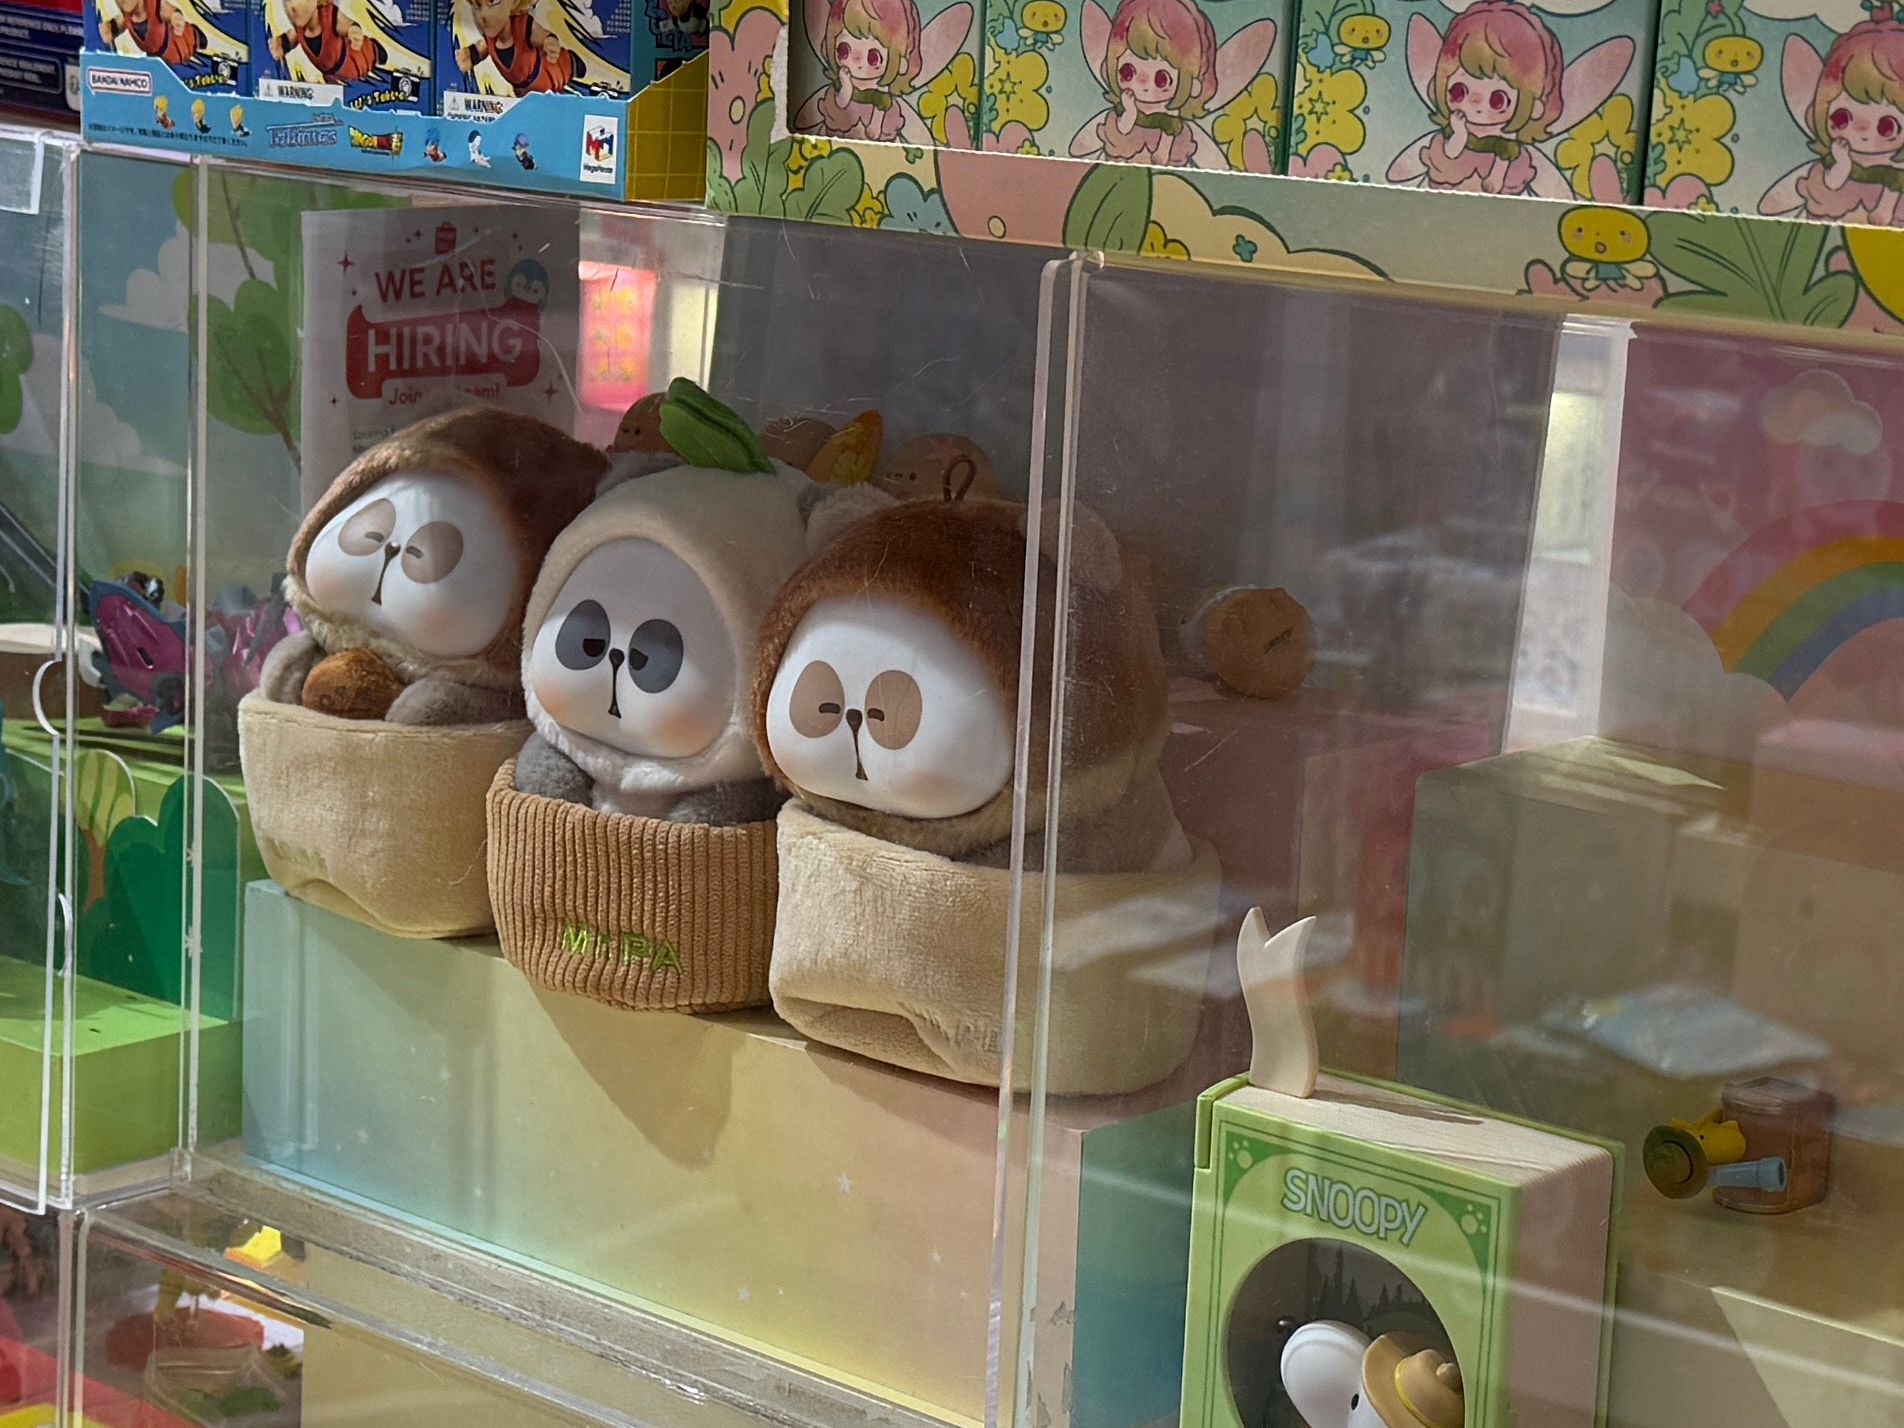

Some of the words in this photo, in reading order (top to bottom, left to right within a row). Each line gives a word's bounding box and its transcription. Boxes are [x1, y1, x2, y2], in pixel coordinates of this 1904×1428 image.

[374, 263, 425, 303] WE
[433, 258, 497, 295] ARE
[366, 321, 523, 372] HIRING
[1280, 1168, 1429, 1248] SNOOPY
